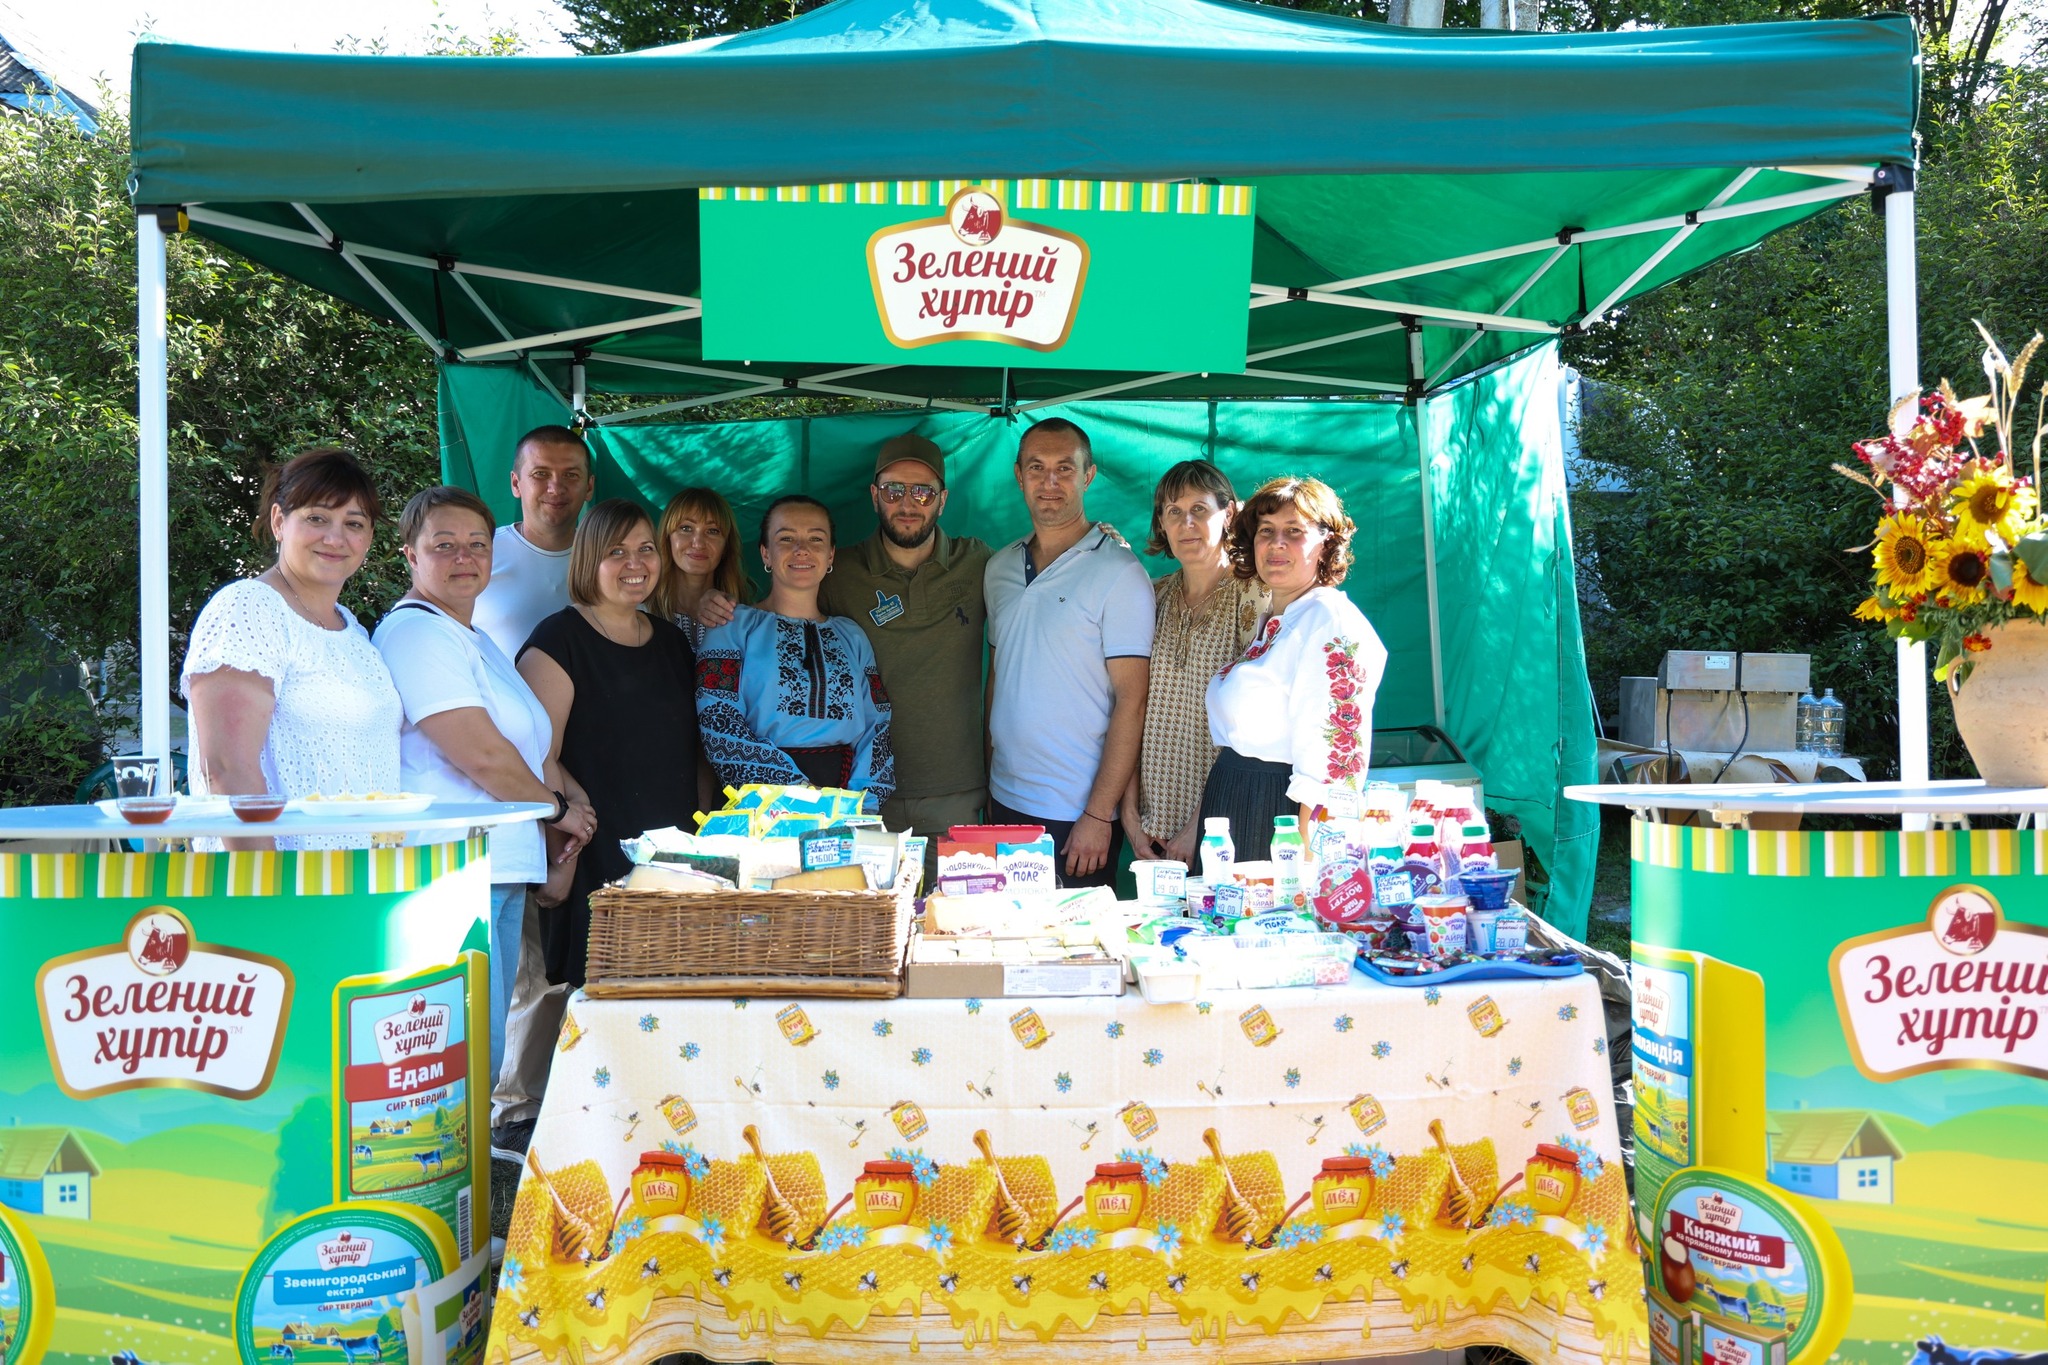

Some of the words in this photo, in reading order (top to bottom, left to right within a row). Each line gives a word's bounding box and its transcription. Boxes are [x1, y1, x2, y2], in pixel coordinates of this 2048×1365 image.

[893, 242, 1060, 284] Зелений
[918, 280, 1034, 329] хутір
[64, 972, 258, 1022] Зелений
[383, 1009, 444, 1041] Зелений
[1897, 995, 2039, 1056] хутір
[94, 1014, 229, 1075] хутір
[395, 1029, 438, 1055] хутір
[388, 1061, 444, 1091] Едам
[386, 1101, 407, 1112] СИР
[408, 1089, 448, 1109] ТВЕРДИЙ
[646, 1182, 675, 1198] МЁД
[1326, 1190, 1355, 1205] МЁД
[1537, 1178, 1560, 1198] МЁД
[868, 1191, 898, 1208] МЁД
[1099, 1196, 1127, 1211] МЁД
[1699, 1199, 1737, 1218] Зелений
[1704, 1211, 1732, 1226] хутір
[1683, 1217, 1760, 1253] Княжий
[321, 1241, 367, 1257] Зелений
[1676, 1231, 1685, 1240] на
[1685, 1235, 1733, 1258] пряженому
[1733, 1252, 1771, 1265] молоці
[328, 1251, 361, 1267] хутір
[1697, 1253, 1709, 1262] СИР
[1709, 1257, 1743, 1270] ТВЕРДИЙ
[283, 1264, 407, 1288] Звенигородський
[326, 1286, 364, 1298] екстра
[317, 1303, 334, 1313] СИР
[336, 1299, 374, 1311] ТВЕРДИЙ
